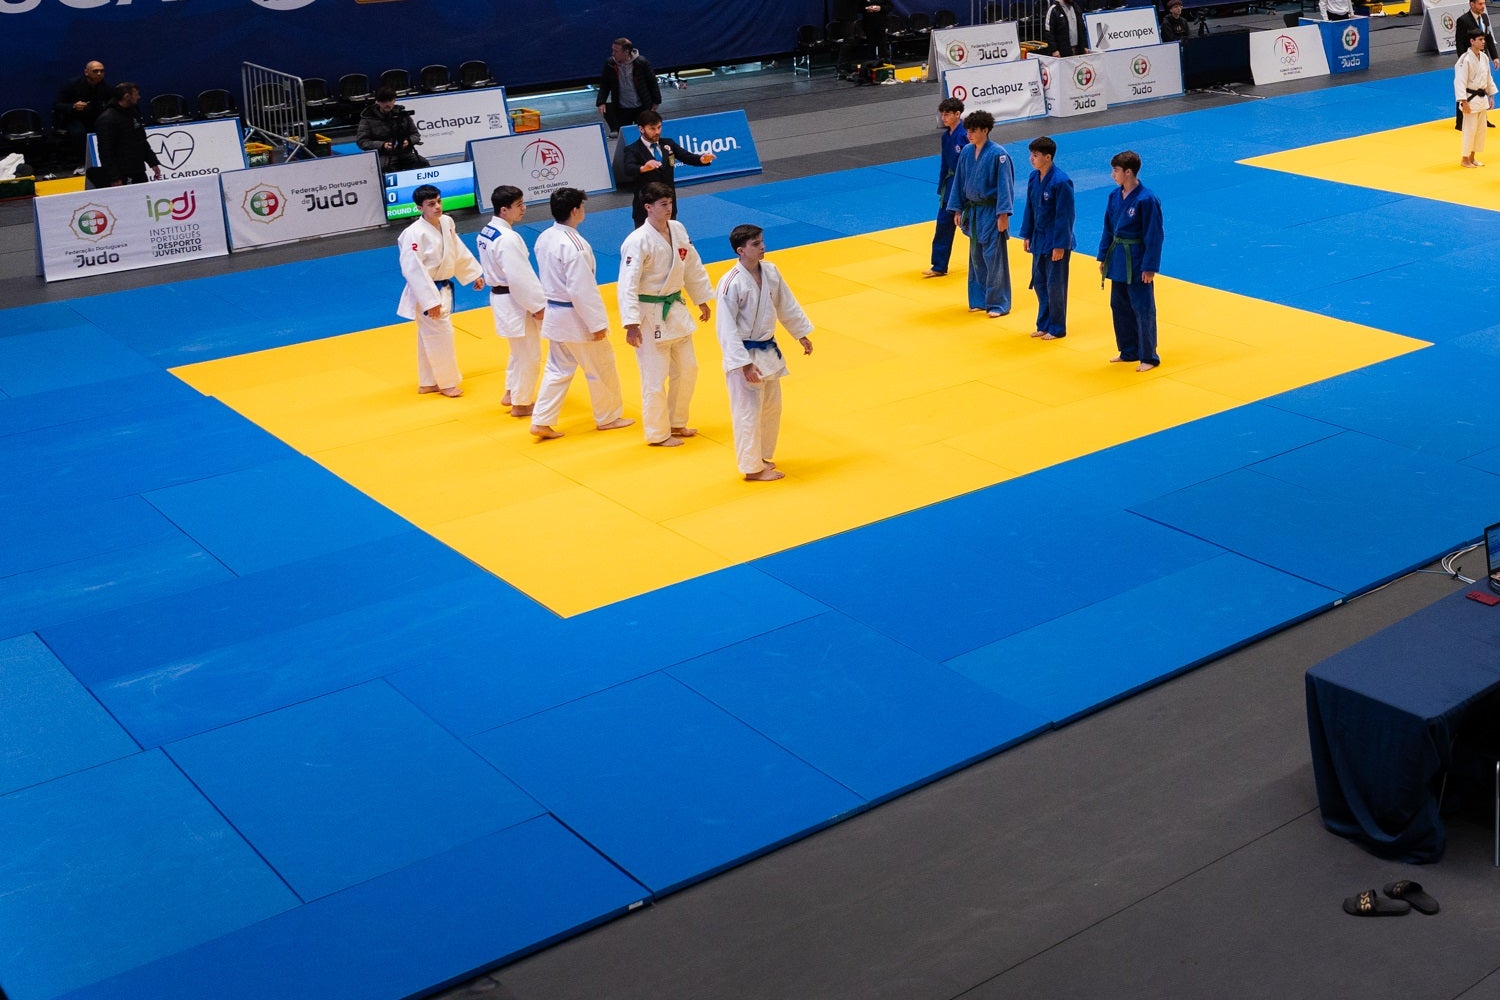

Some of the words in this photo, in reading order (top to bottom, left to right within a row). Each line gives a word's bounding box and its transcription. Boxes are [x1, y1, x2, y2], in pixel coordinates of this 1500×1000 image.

[979, 47, 1008, 60] Judo
[1341, 57, 1361, 68] Judo
[972, 83, 1023, 97] Cachapuz
[1133, 85, 1152, 95] Judo
[1074, 99, 1096, 110] Judo
[416, 115, 481, 131] Cachapuz
[171, 167, 219, 179] CARDOSO
[416, 171, 439, 180] EJND
[291, 184, 327, 195] Federação
[329, 179, 367, 190] Portuguesa
[388, 176, 394, 186] 1
[305, 190, 358, 212] Judo
[388, 192, 397, 203] 0
[146, 190, 196, 222] ipdj
[387, 208, 412, 217] ROUND
[150, 223, 200, 236] INSTITUTO
[150, 231, 201, 243] PORTUGUÊS
[157, 238, 202, 249] DESPORTO
[154, 245, 202, 257] JUVENTUDE
[77, 251, 120, 268] Judo
